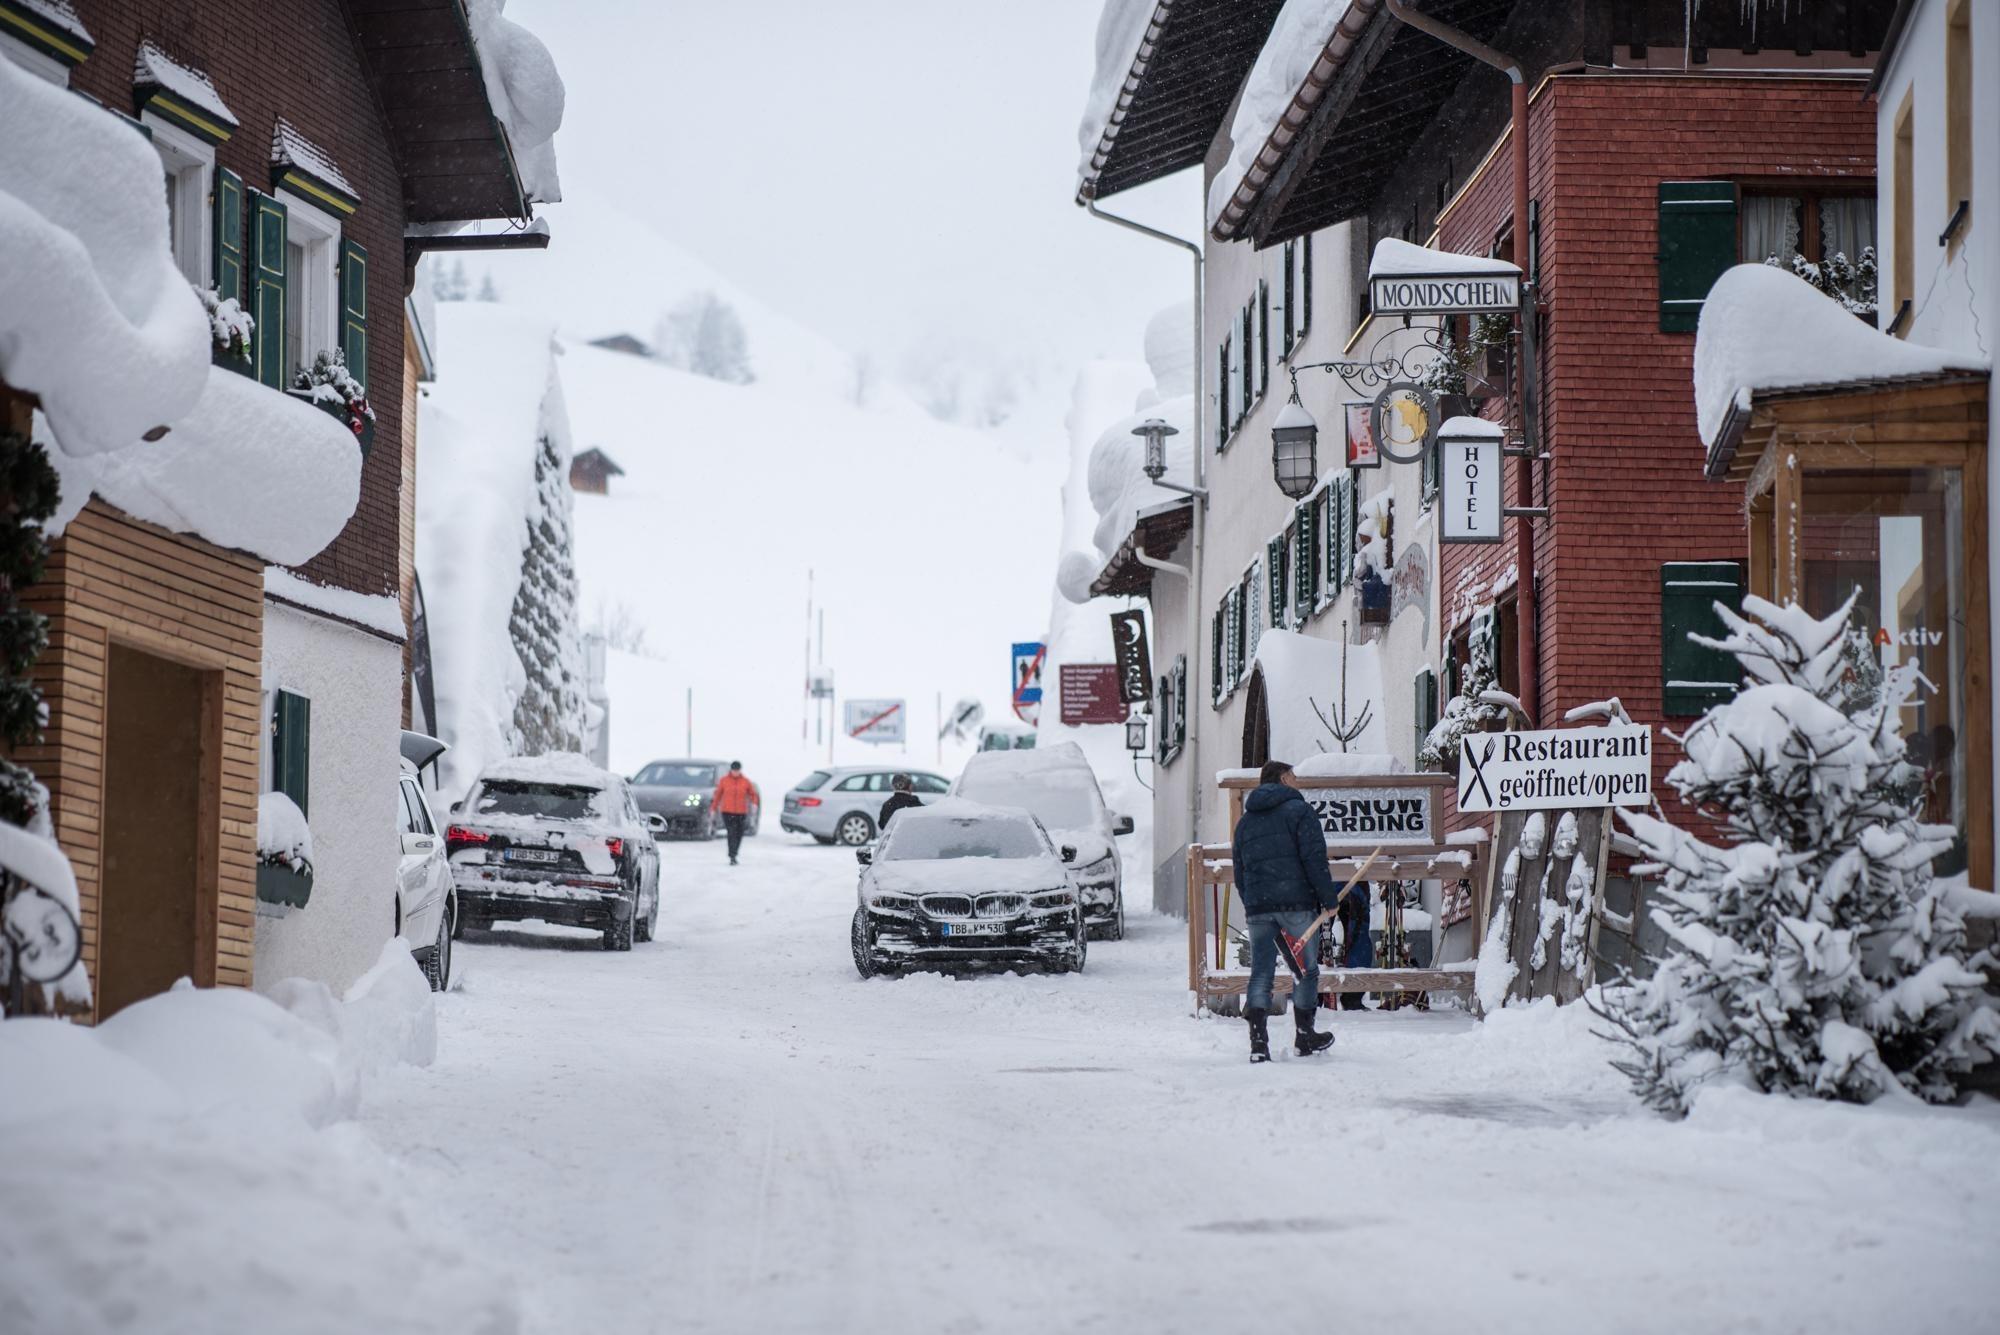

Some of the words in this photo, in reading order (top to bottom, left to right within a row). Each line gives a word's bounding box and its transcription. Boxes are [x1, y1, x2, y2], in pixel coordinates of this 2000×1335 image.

[1382, 282, 1512, 307] MONDSCHEIN
[1464, 446, 1479, 530] HOTEL
[1502, 729, 1649, 762] Restaurant
[1499, 768, 1647, 807] geöffnet/open
[1324, 813, 1424, 832] ARDING
